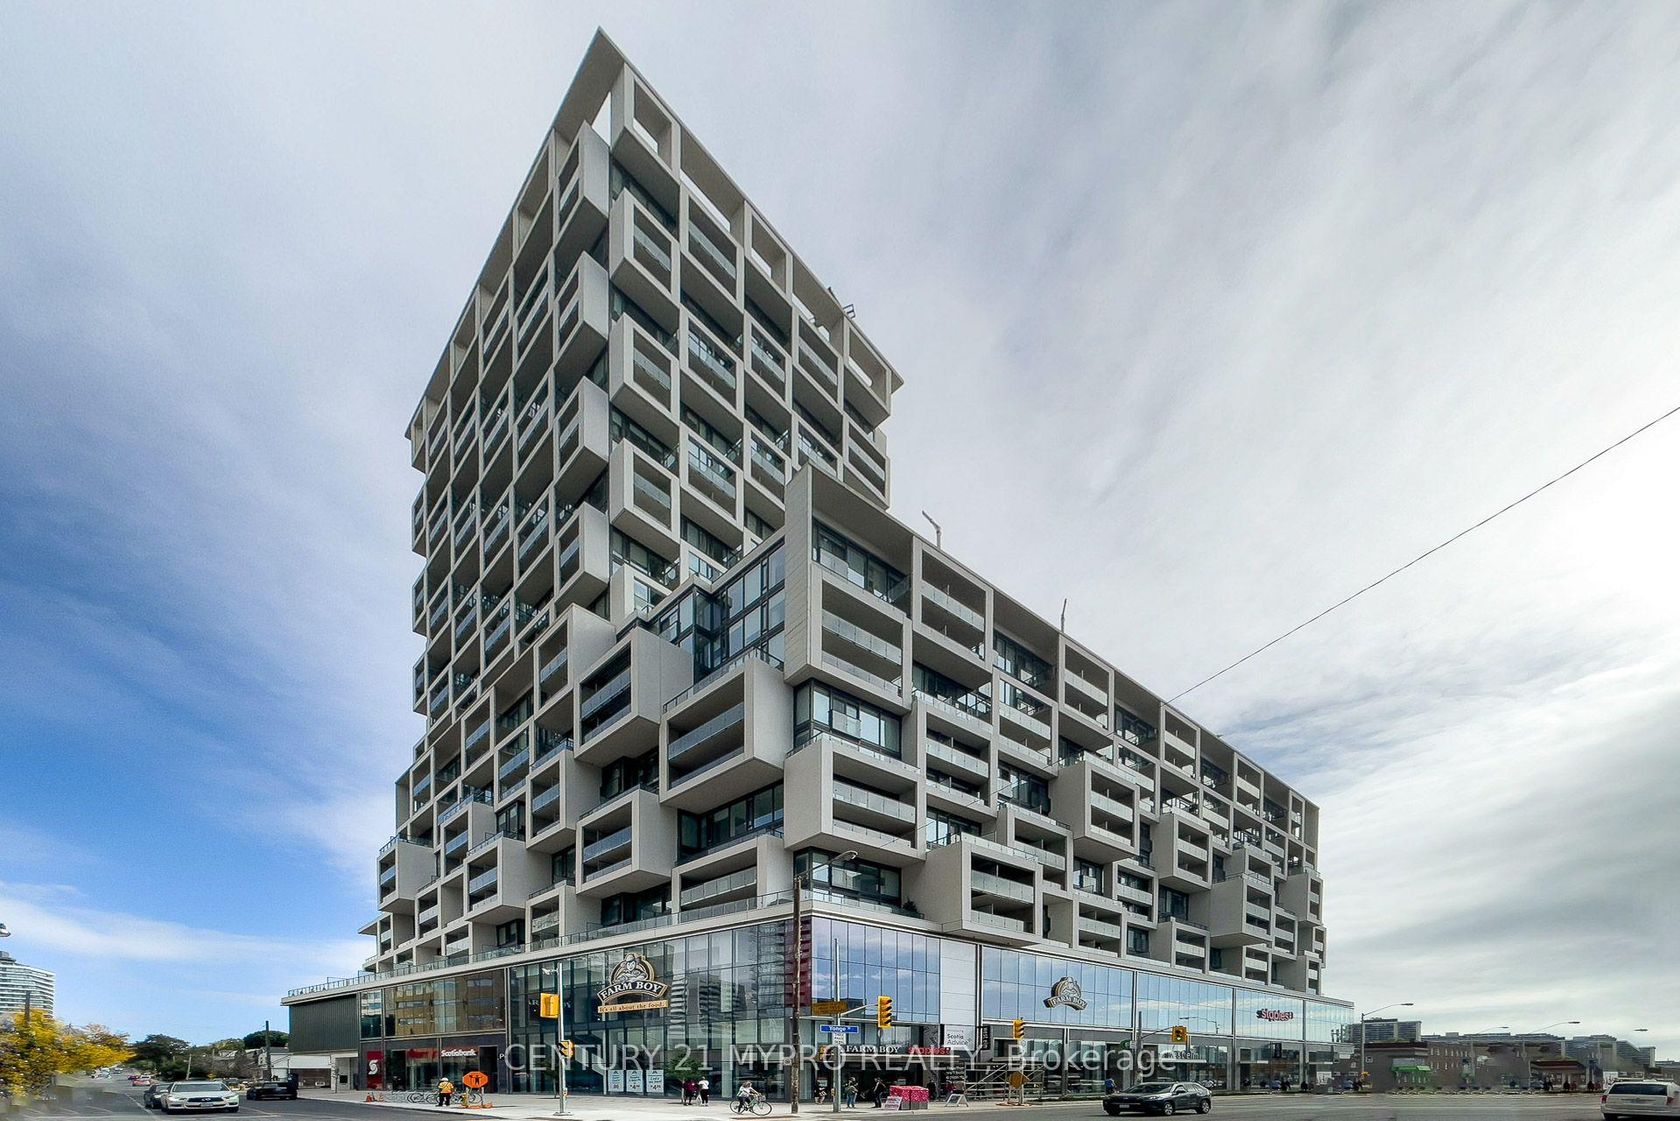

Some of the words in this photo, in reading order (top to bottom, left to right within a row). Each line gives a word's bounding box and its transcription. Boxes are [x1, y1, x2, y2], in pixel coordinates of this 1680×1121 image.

[601, 981, 633, 999] FARM
[635, 981, 661, 993] BOY
[1052, 995, 1072, 1006] FARM
[1073, 997, 1087, 1008] BOY
[830, 1025, 846, 1033] Yonge
[441, 1049, 477, 1057] Scotiabank
[846, 1045, 878, 1053] FARM
[880, 1045, 901, 1053] BOY
